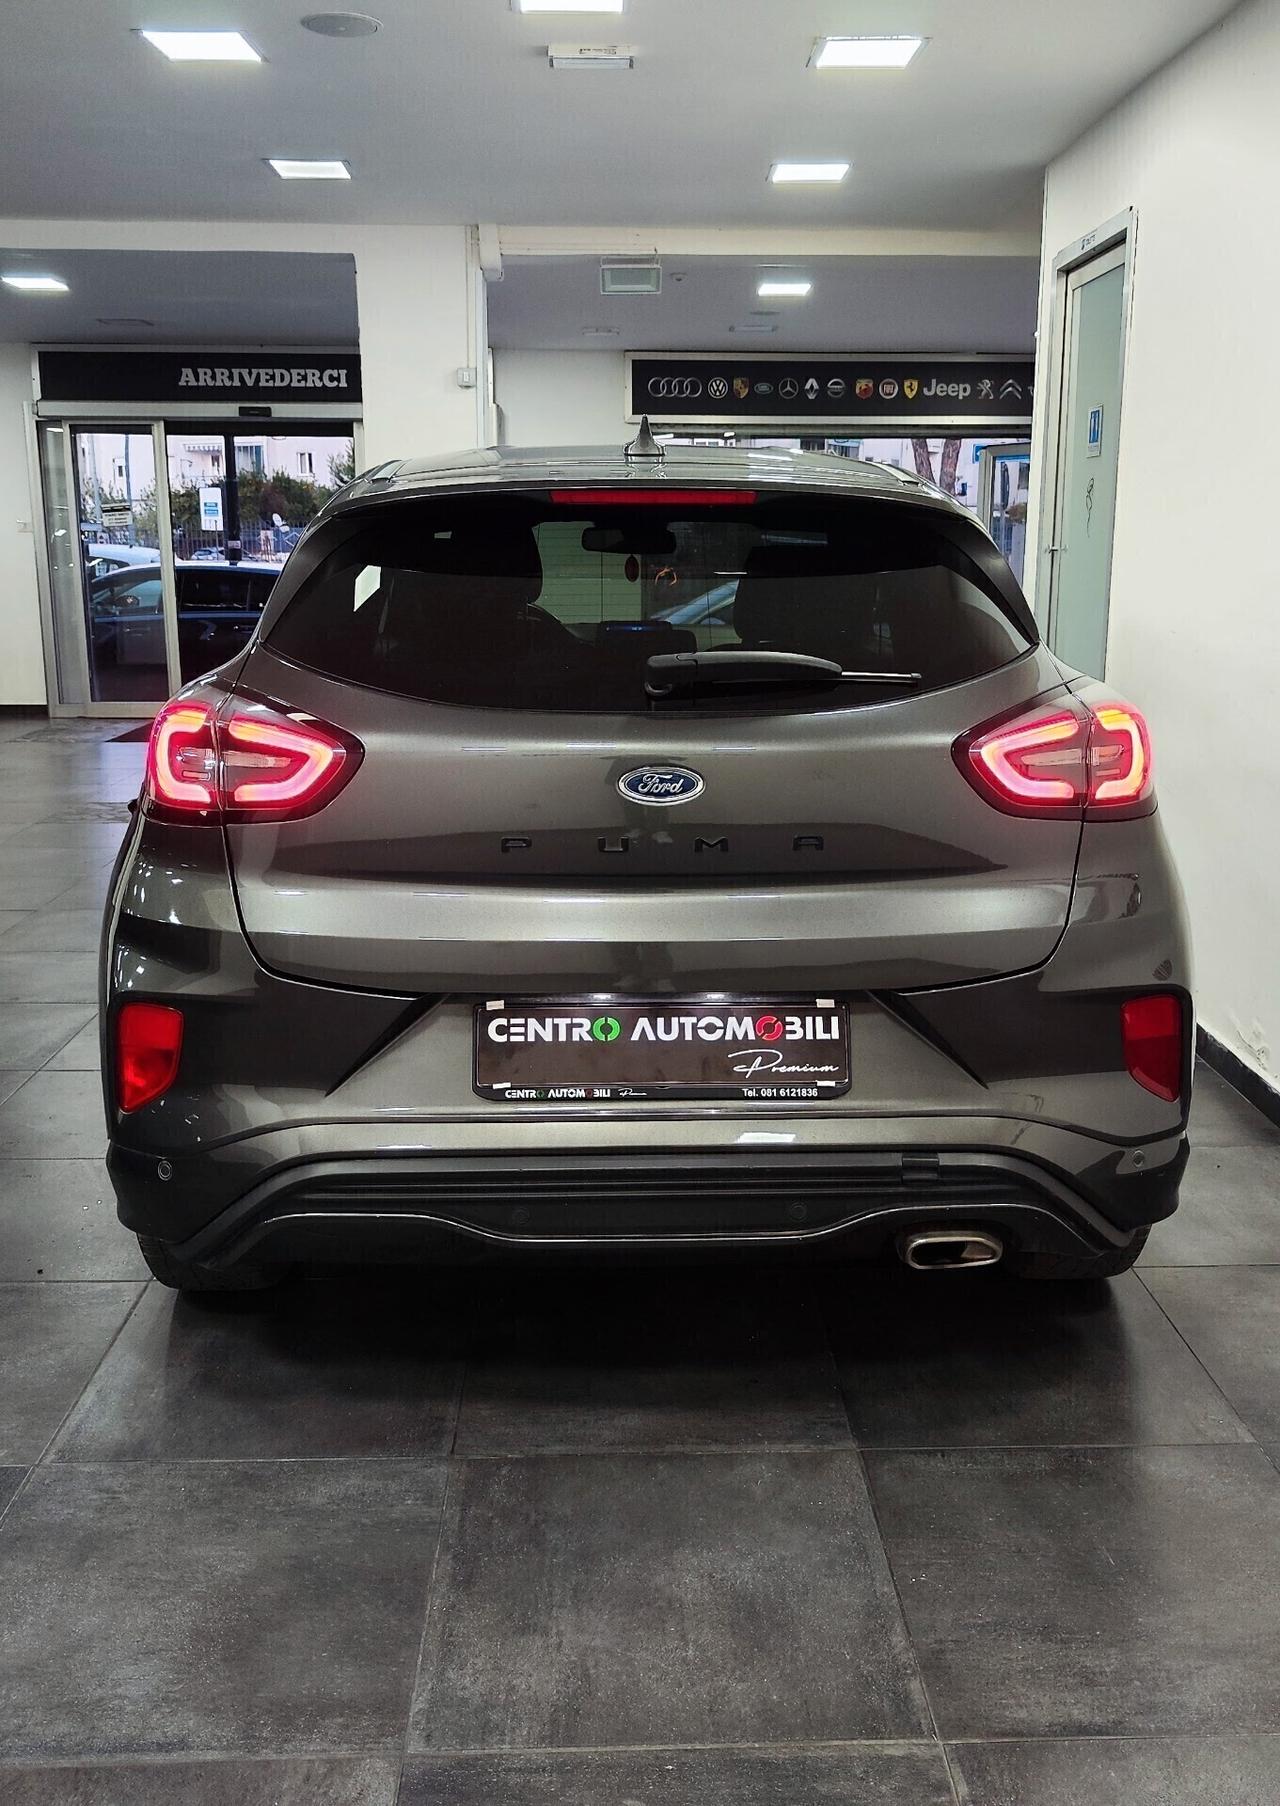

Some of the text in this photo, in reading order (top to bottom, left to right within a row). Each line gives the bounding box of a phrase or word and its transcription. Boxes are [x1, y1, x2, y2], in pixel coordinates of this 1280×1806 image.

[178, 368, 348, 388] ARRIVEDERCI
[923, 379, 971, 399] Jeep
[638, 773, 684, 793] Ford
[501, 836, 824, 853] PUMA
[487, 1015, 840, 1043] CENTRO AUTOMOBILI
[727, 1049, 839, 1079] Premium
[505, 1089, 544, 1099] CENTRO
[548, 1088, 611, 1098] AUTOMOBILI
[742, 1088, 819, 1097] Tel. 081 6121836
